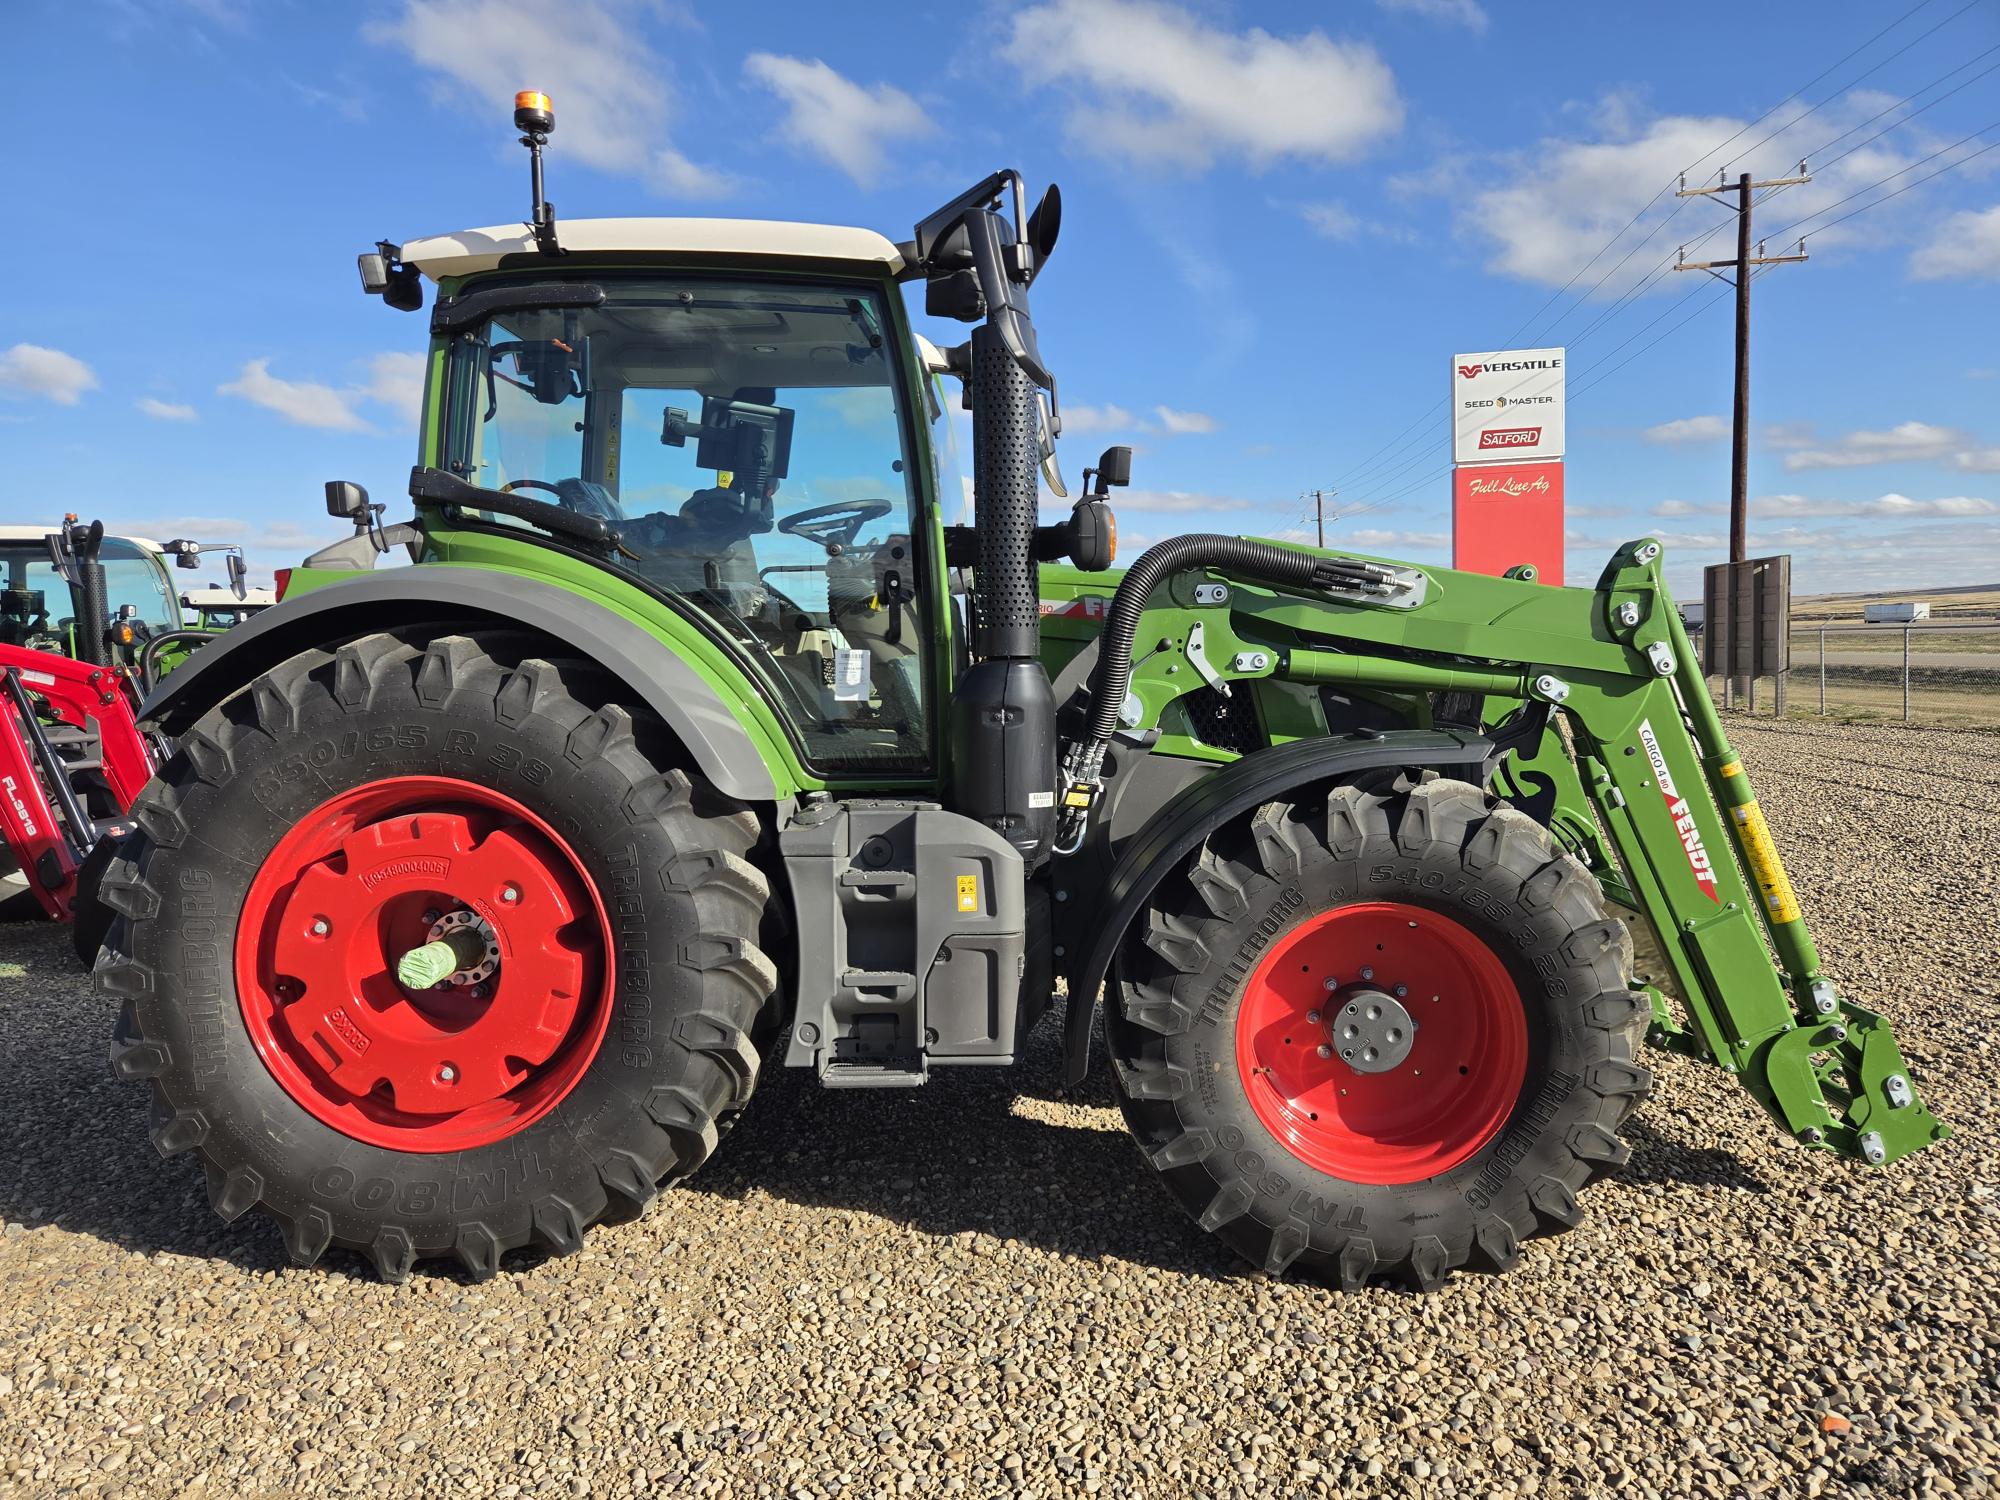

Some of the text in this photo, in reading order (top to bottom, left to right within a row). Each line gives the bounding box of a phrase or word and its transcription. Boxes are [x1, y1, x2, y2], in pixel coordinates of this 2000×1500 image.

[1483, 359, 1561, 372] VERSATILE
[1464, 396, 1553, 409] SEED MASTER
[1482, 430, 1539, 446] SALFORD
[1469, 475, 1551, 496] Full Line Ag
[443, 728, 479, 756] R
[488, 743, 553, 786] 38
[1641, 730, 1662, 768] CARGO
[1669, 798, 1718, 884] FENDT
[178, 867, 231, 1092] TRELLEBORG
[605, 843, 653, 1069] TRELLEBORG
[1200, 883, 1305, 1029] TRELLEBORG
[1509, 923, 1541, 951] R
[1531, 953, 1570, 1000] 28
[1465, 1068, 1581, 1210] TRELLEBORG
